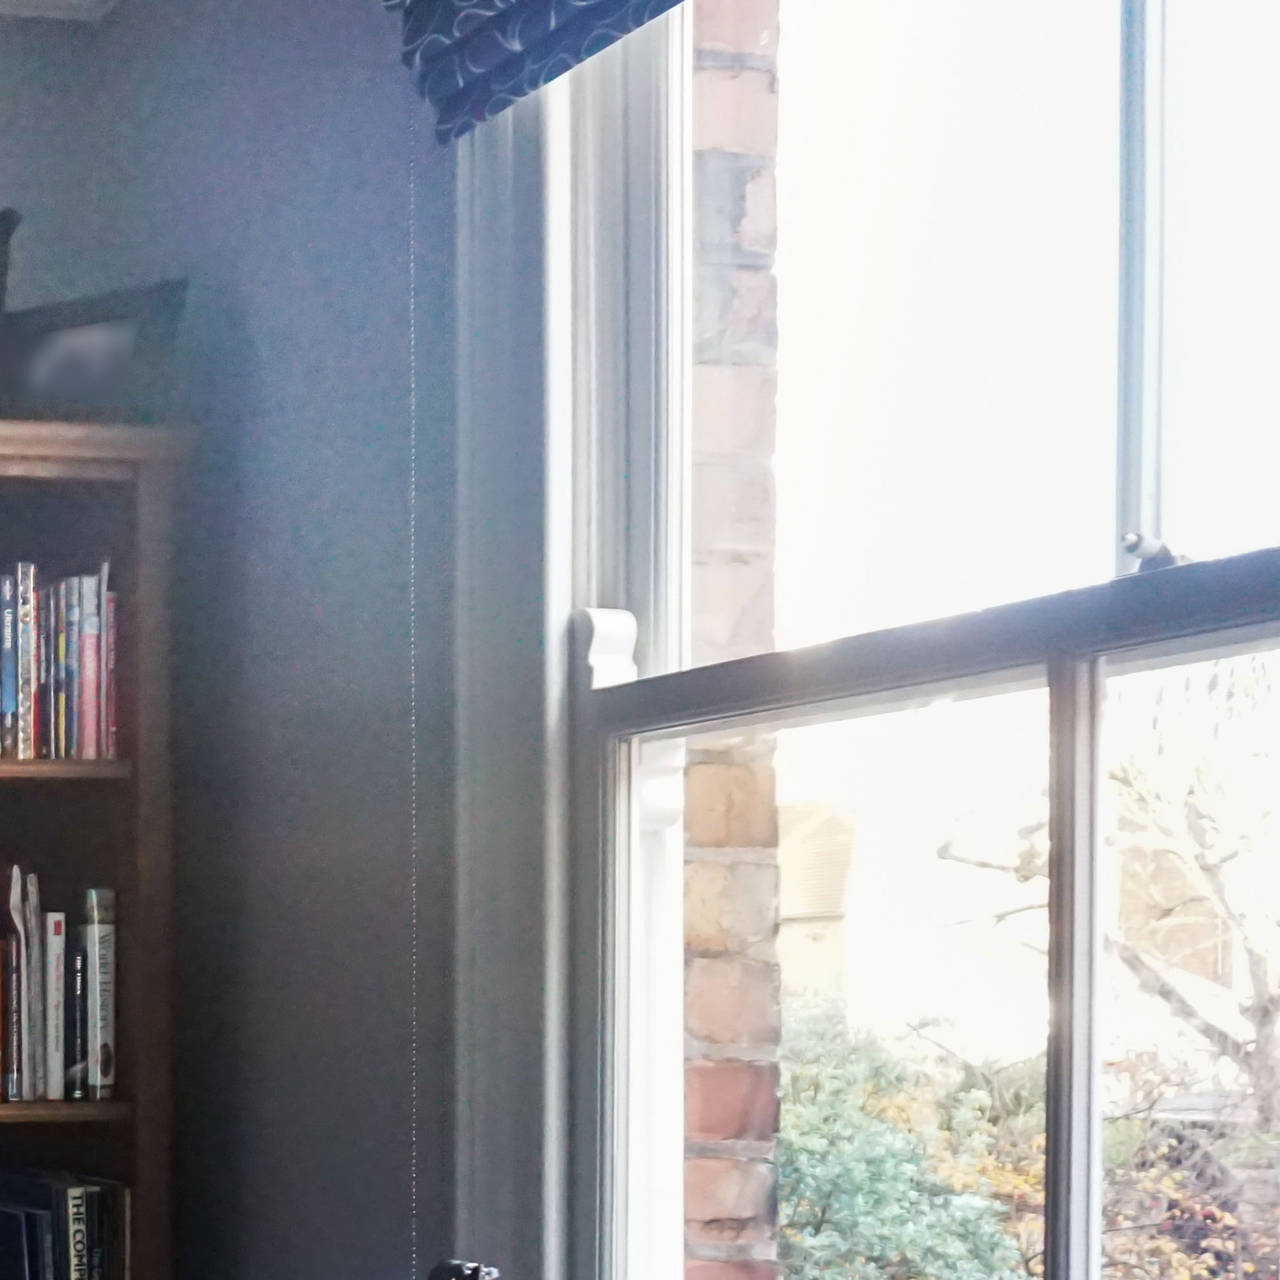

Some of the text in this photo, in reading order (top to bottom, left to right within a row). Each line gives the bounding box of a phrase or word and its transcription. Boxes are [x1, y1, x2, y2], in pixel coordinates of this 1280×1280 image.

[3, 609, 14, 649] Ukraine
[98, 933, 112, 975] World
[72, 1192, 85, 1225] THE
